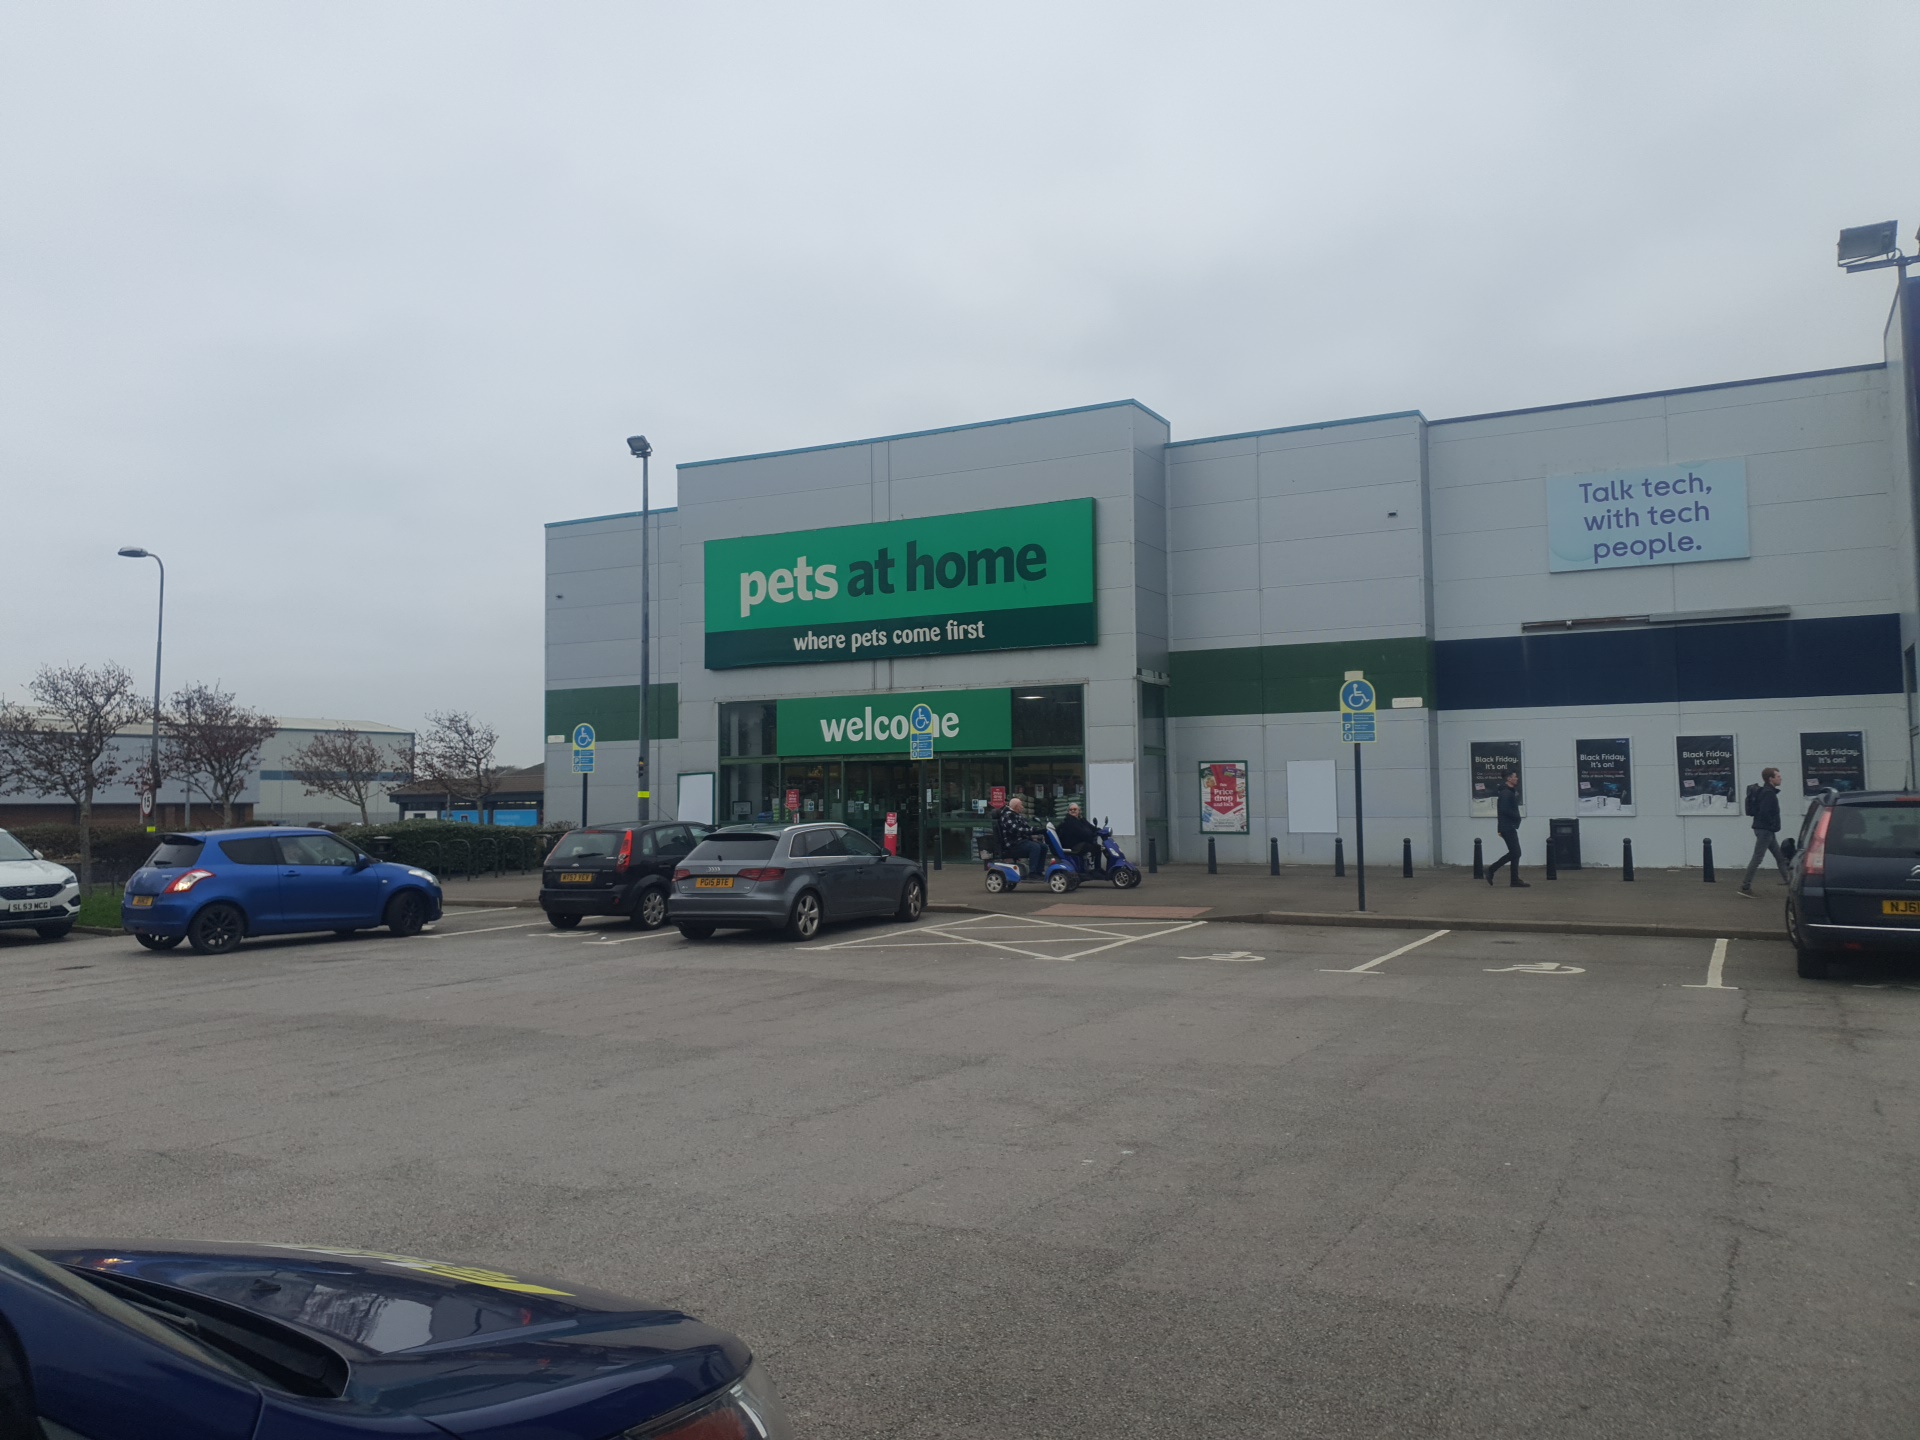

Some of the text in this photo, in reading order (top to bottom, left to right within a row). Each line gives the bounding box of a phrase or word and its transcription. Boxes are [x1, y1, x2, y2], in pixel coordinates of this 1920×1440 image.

[1579, 472, 1712, 503] Talk tech,
[1583, 501, 1710, 531] with tech
[1593, 532, 1702, 564] people.
[740, 540, 1047, 618] pets at home
[793, 619, 985, 652] where pets come first
[1601, 753, 1626, 762] Friday.
[144, 796, 151, 808] 15
[1213, 788, 1234, 796] Price
[1214, 795, 1234, 803] drop
[700, 878, 729, 886] PG15 BTE
